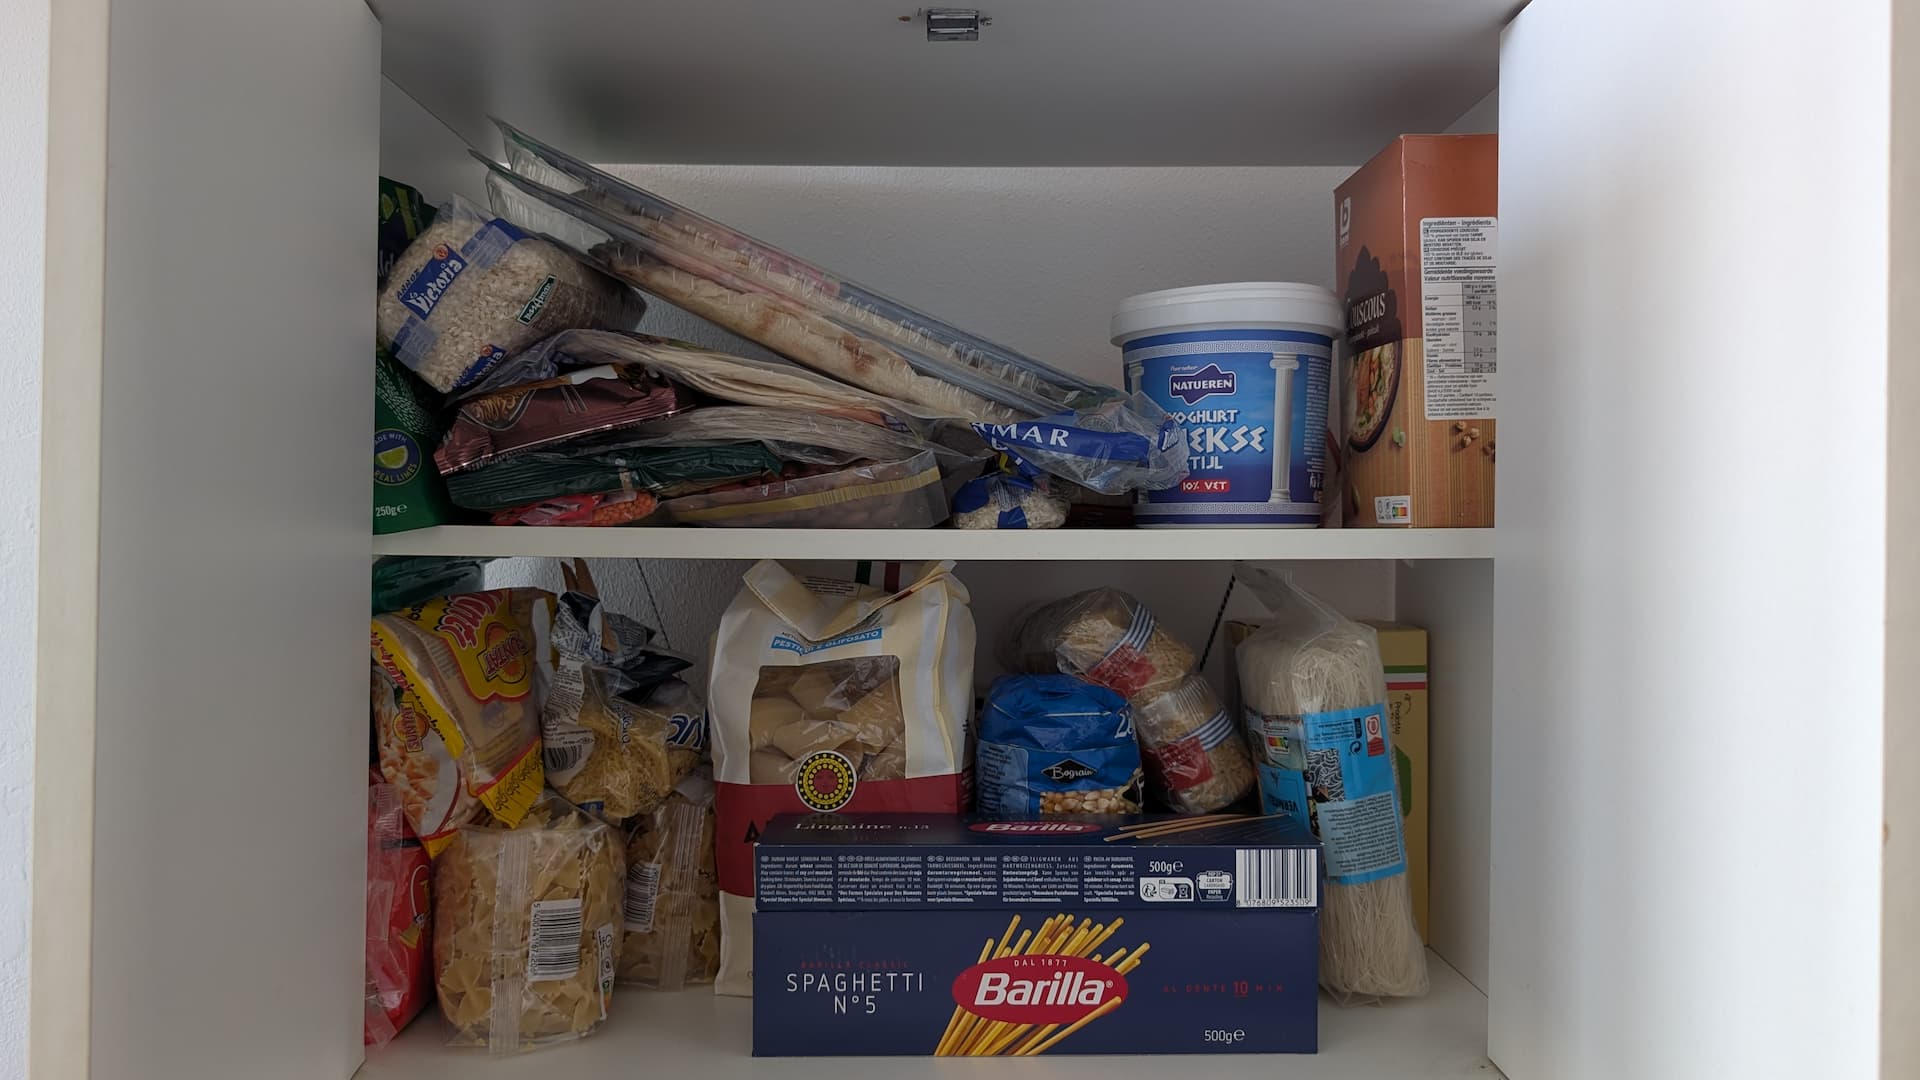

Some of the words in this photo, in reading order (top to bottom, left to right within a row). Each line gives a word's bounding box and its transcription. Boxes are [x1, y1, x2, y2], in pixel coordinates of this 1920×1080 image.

[405, 257, 462, 315] Victoria
[1172, 379, 1233, 391] NATUEREN
[1190, 456, 1223, 470] TIJL
[1183, 482, 1200, 491] 10%
[1205, 482, 1227, 491] VET
[985, 823, 1084, 831] Barilla
[1014, 959, 1035, 967] DAL
[1041, 959, 1067, 967] 1877
[786, 972, 923, 993] SPAGHETTI
[974, 971, 1106, 1006] Barilla
[1163, 984, 1177, 993] AL
[1185, 984, 1227, 993] DENTE
[1232, 980, 1249, 995] 10
